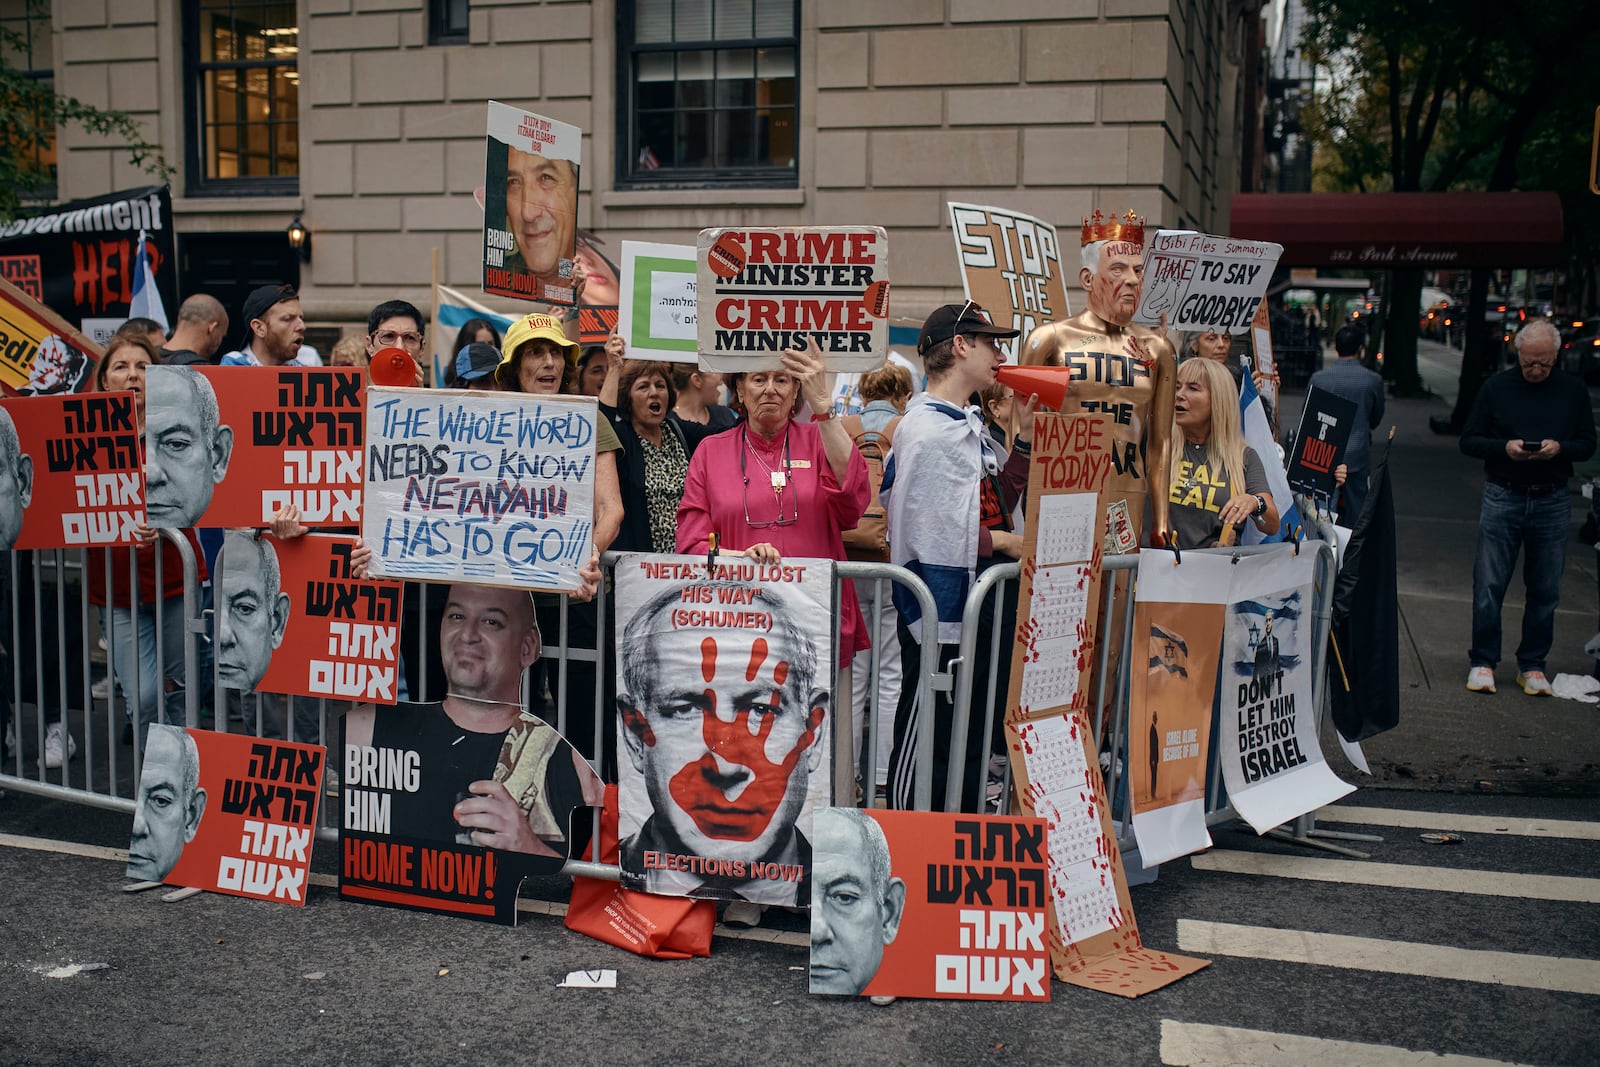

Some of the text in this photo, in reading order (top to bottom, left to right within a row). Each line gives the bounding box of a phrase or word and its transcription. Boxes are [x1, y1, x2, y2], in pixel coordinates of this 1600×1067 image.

[486, 228, 514, 251] BRING
[486, 247, 504, 267] HIM
[714, 245, 743, 268] CRIME
[953, 207, 1057, 281] STOP
[1160, 236, 1186, 251] Bibi
[1189, 237, 1217, 253] Files
[1359, 246, 1396, 262] Park
[1400, 246, 1458, 261] Avenue
[710, 250, 740, 273] MINISTER
[1154, 256, 1261, 285] TIME TO SAY
[486, 268, 511, 292] HOME
[512, 273, 537, 296] NOW!
[1001, 270, 1052, 315] THE
[528, 318, 553, 329] NOW
[715, 298, 873, 330] CRIME
[1178, 293, 1262, 328] GOODBYE
[715, 330, 872, 353] MINISTER
[1065, 352, 1150, 387] STOP
[278, 373, 361, 407] אתה
[63, 397, 133, 434] אתה
[253, 412, 362, 446] הראש
[374, 399, 592, 449] THE WHOLE WORLD
[1081, 401, 1134, 426] THE
[46, 435, 138, 472] הראש
[1033, 415, 1104, 456] MAYBE
[1301, 435, 1337, 468] NOW
[284, 450, 362, 484] אתה
[369, 443, 591, 483] NEEDS TO KNOW
[1036, 452, 1110, 495] TODAY?
[1178, 461, 1226, 488] EAL
[75, 472, 142, 507] אתה
[262, 489, 361, 523] אשם
[402, 476, 568, 525] NETANYAHU
[1169, 481, 1220, 513] EAL
[61, 510, 143, 544] אשם
[381, 516, 451, 559] HAS
[455, 518, 494, 560] TO
[759, 566, 806, 583] LOST
[305, 581, 399, 622] הראש
[681, 587, 762, 605] HIS WAY"
[671, 609, 773, 633] (SCHUMER)
[328, 621, 397, 661] אתה
[308, 659, 395, 700] אשם
[1238, 671, 1284, 709] DON'T
[1238, 693, 1295, 732] LET HIM
[1238, 715, 1296, 753] DESTROY
[248, 743, 321, 786] אתה
[345, 744, 421, 793] BRING
[1240, 737, 1307, 784] ISRAEL
[221, 778, 316, 825] הראש
[344, 788, 391, 834] HIM
[240, 819, 310, 862] אתה
[955, 820, 1043, 863] אתה
[216, 855, 305, 901] אשם
[344, 838, 498, 899] HOME NOW!
[643, 850, 804, 883] ELECTIONS NOW!
[927, 864, 1045, 908] הראש
[959, 909, 1045, 951] אתה
[935, 954, 1045, 996] אשם
